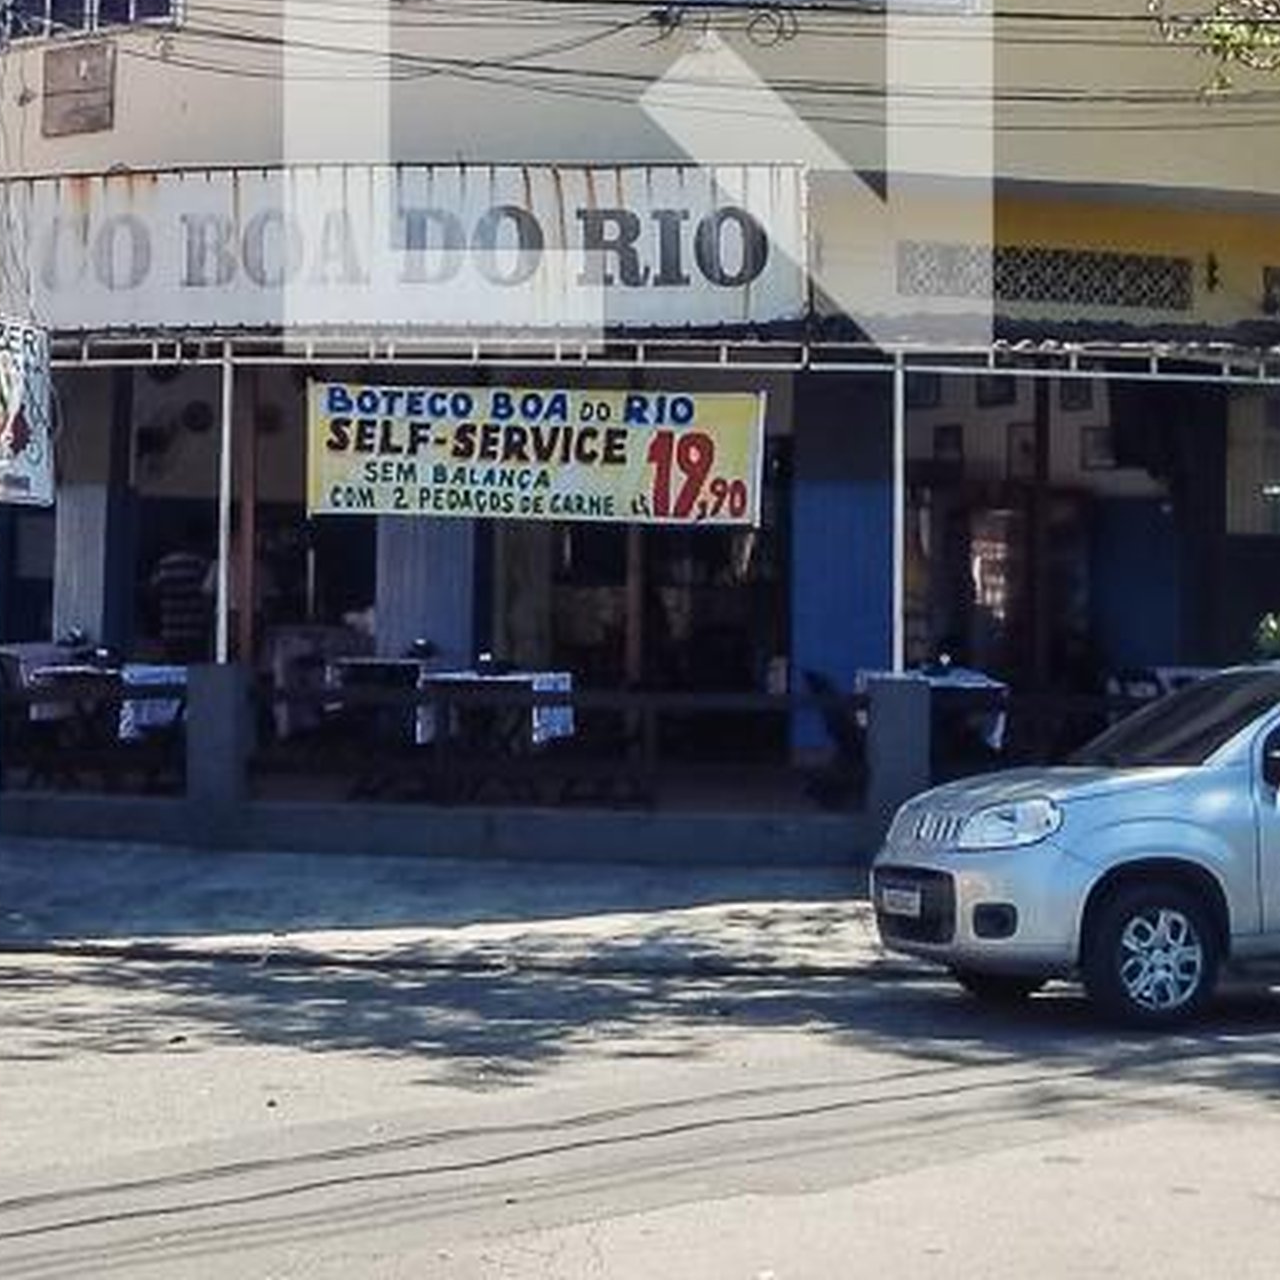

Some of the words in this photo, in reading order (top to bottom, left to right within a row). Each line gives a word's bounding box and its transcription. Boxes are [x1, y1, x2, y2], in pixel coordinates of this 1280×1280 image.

[182, 207, 369, 288] BOA
[398, 205, 544, 288] DO
[576, 206, 769, 288] RIO
[328, 387, 472, 418] BOTECO
[491, 392, 568, 422] BOA
[580, 402, 611, 421] DO
[624, 395, 694, 424] RIO
[326, 418, 628, 465] SELF-SERVICE
[364, 461, 417, 483] SEM
[648, 429, 747, 519] 19,90
[330, 485, 375, 508] COM
[393, 487, 409, 509] 2
